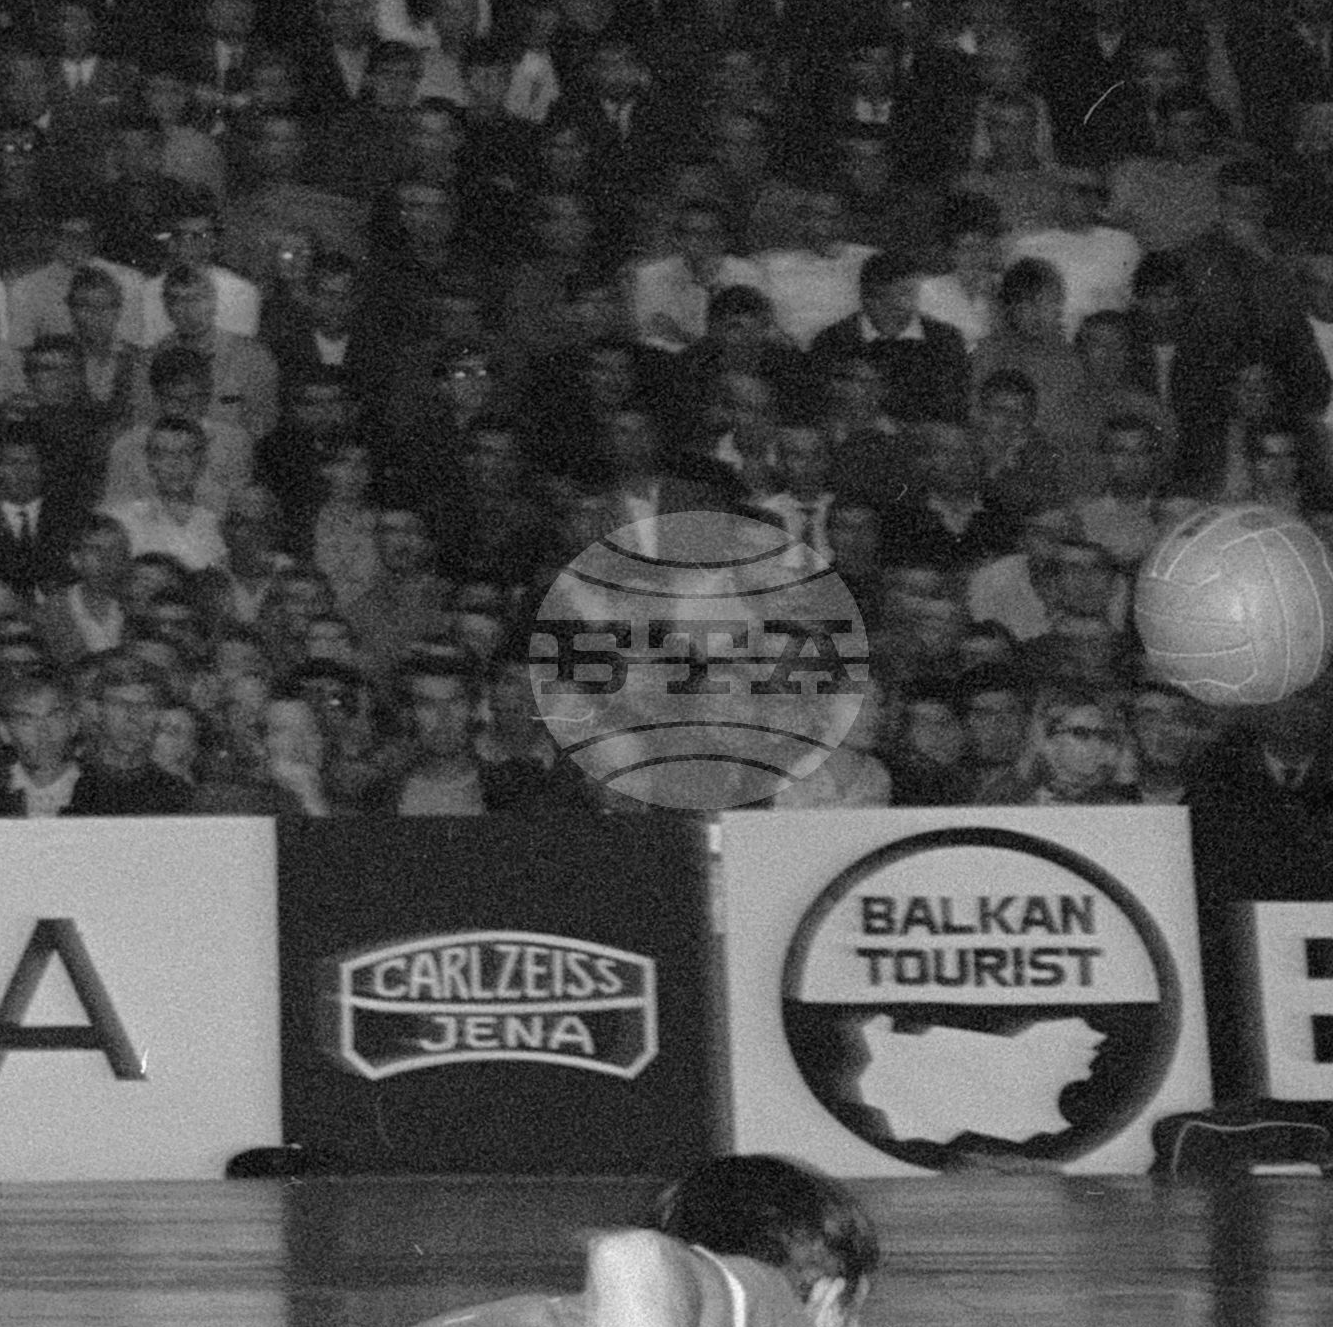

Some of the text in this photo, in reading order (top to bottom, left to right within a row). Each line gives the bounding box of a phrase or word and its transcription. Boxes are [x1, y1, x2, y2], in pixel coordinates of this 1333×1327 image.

[860, 894, 1096, 936] BALKAN
[856, 946, 1102, 987] TOURIST
[418, 1015, 596, 1056] JENA
